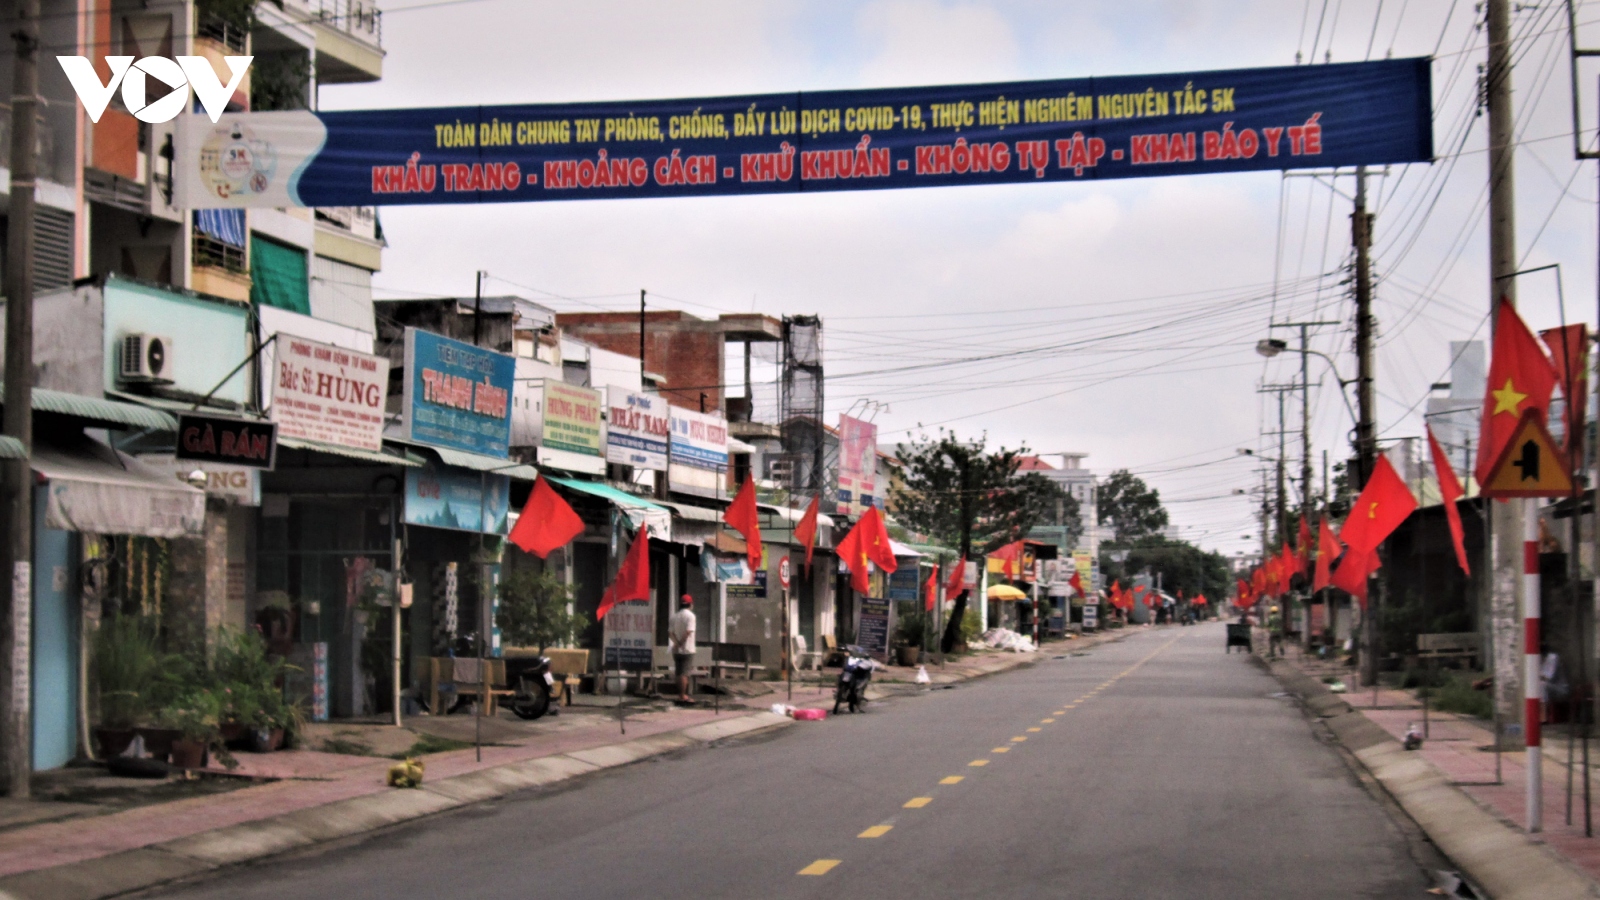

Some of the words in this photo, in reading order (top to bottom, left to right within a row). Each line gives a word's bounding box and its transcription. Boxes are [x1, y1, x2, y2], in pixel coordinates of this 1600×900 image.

[435, 123, 475, 148] TOÀN
[479, 119, 513, 147] DÂN
[516, 119, 571, 145] CHUNG
[574, 119, 601, 144] TAY
[604, 112, 665, 143] PHÒNG,
[669, 107, 729, 141] CHỐNG,
[734, 103, 766, 137] ĐẨY
[770, 106, 797, 135] LÙI
[800, 109, 841, 137] DỊCH
[845, 105, 926, 133] COVID-19,
[930, 101, 975, 132] THỰC
[979, 96, 1020, 129] HIỆN
[1024, 92, 1093, 123] NGHIÊM
[1097, 87, 1169, 119] NGUYÊN
[1173, 82, 1207, 115] TẮC
[1212, 88, 1235, 113] 5K
[372, 152, 437, 193] KHẨU
[442, 162, 521, 192] TRANG
[527, 174, 537, 184] -
[544, 149, 648, 189] KHOẢNG
[654, 149, 717, 186] CÁCH
[723, 167, 734, 178] -
[741, 141, 796, 182] KHỬ
[801, 134, 890, 180] KHUẨN
[898, 160, 909, 170] -
[916, 137, 1011, 175] KHÔNG
[1016, 140, 1050, 178] TỤ
[1055, 132, 1106, 175] TẬP
[1112, 149, 1124, 160] -
[1131, 133, 1196, 165] KHAI
[1203, 122, 1259, 160] BÁO
[1264, 127, 1283, 156] Y
[1287, 112, 1322, 155] TẾ
[279, 361, 299, 391] Bác
[315, 367, 380, 408] HÙNG
[422, 367, 473, 411] THANH
[183, 422, 217, 455] GÀ
[220, 426, 269, 460] RÁN
